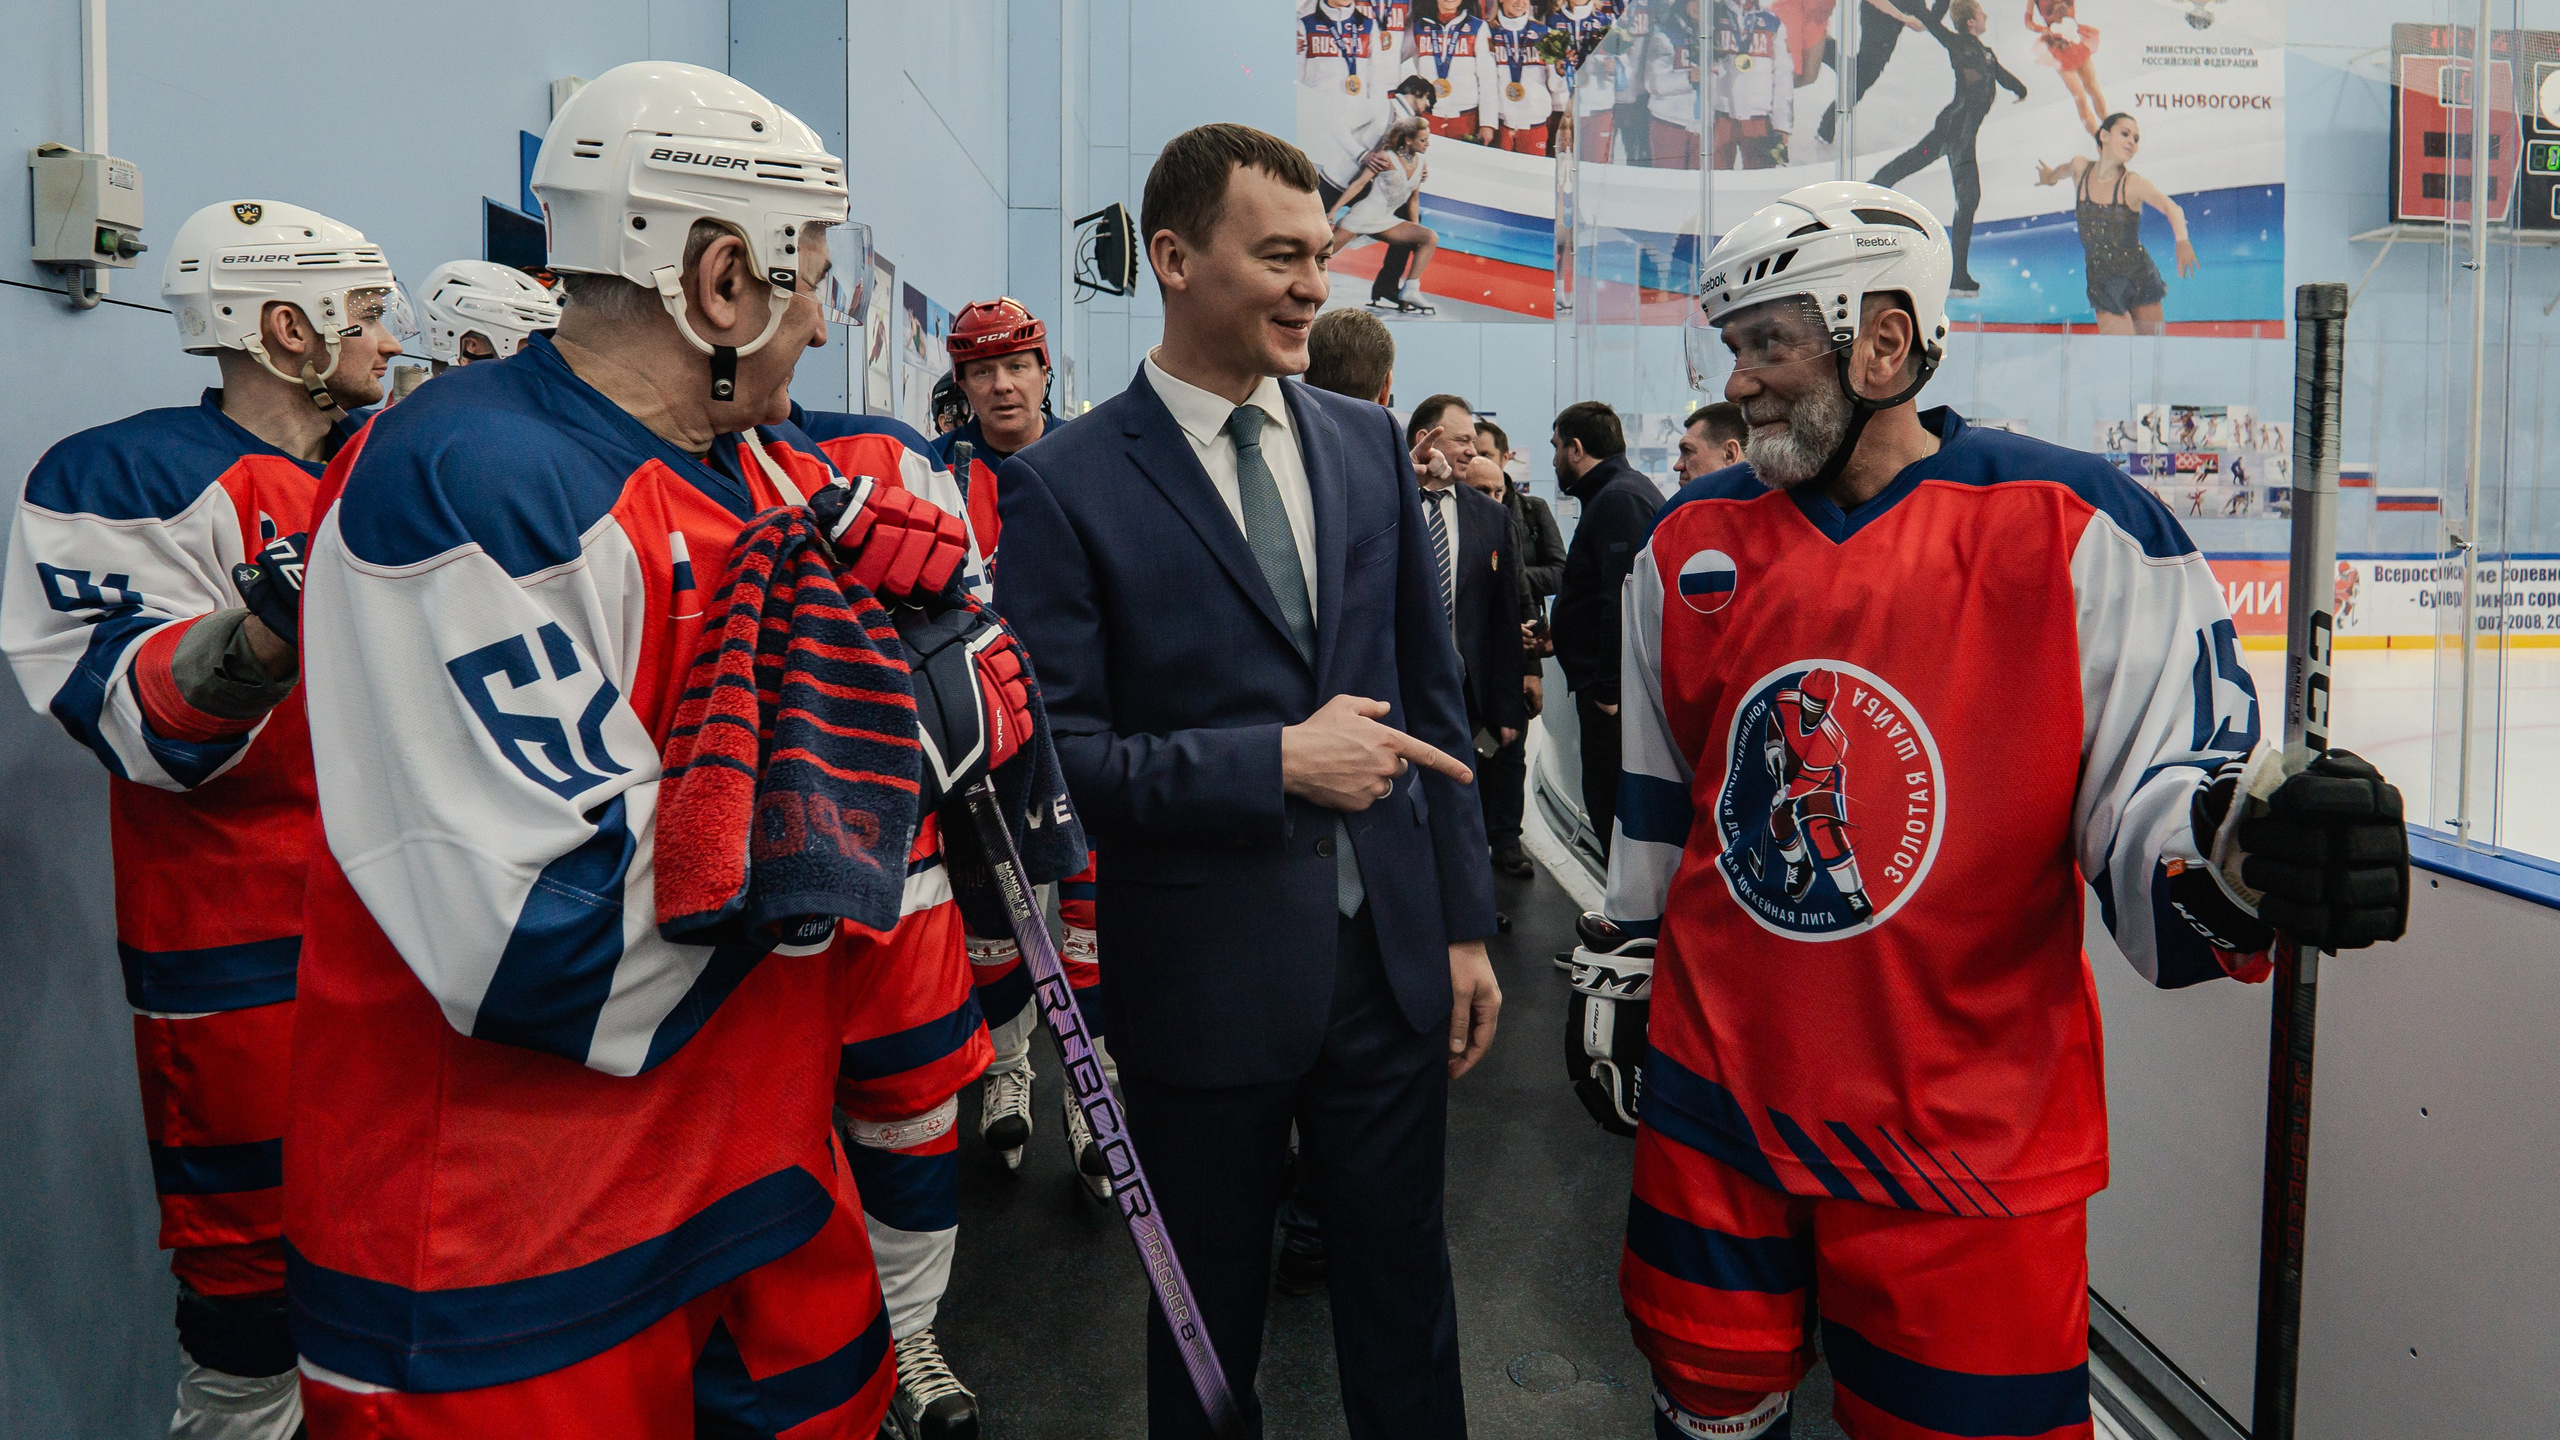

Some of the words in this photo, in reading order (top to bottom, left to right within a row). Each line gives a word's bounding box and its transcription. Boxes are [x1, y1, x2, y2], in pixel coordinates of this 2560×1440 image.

[2145, 45, 2216, 55] МИНИСТЕРСТВО
[2220, 46, 2254, 55] СПОРТА
[2141, 56, 2201, 66] РОССИЙСКОЙ
[2203, 57, 2259, 68] ФЕДЕРАЦИИ
[2135, 93, 2168, 110] УТЦ
[2172, 93, 2272, 110] НОВОГОРСК
[650, 148, 749, 171] BAUER
[1856, 237, 1897, 247] Reebok
[222, 254, 290, 264] BAUER
[976, 331, 1011, 344] CCM
[2503, 567, 2560, 583] соревн
[2219, 581, 2282, 615] ИИ
[1851, 687, 1919, 762] ШАЙБА
[1723, 699, 1767, 816] КОНТИНЕНТАЛЬНАЯ
[1884, 770, 1929, 884] ЗОЛОТАЯ
[1004, 861, 1031, 919] NANOLITE
[1736, 873, 1795, 923] ХОККЕЙНАЯ
[1801, 911, 1836, 925] ЛИГА
[1035, 972, 1152, 1221] RIBCOR
[1142, 1226, 1190, 1322] TRIGGER
